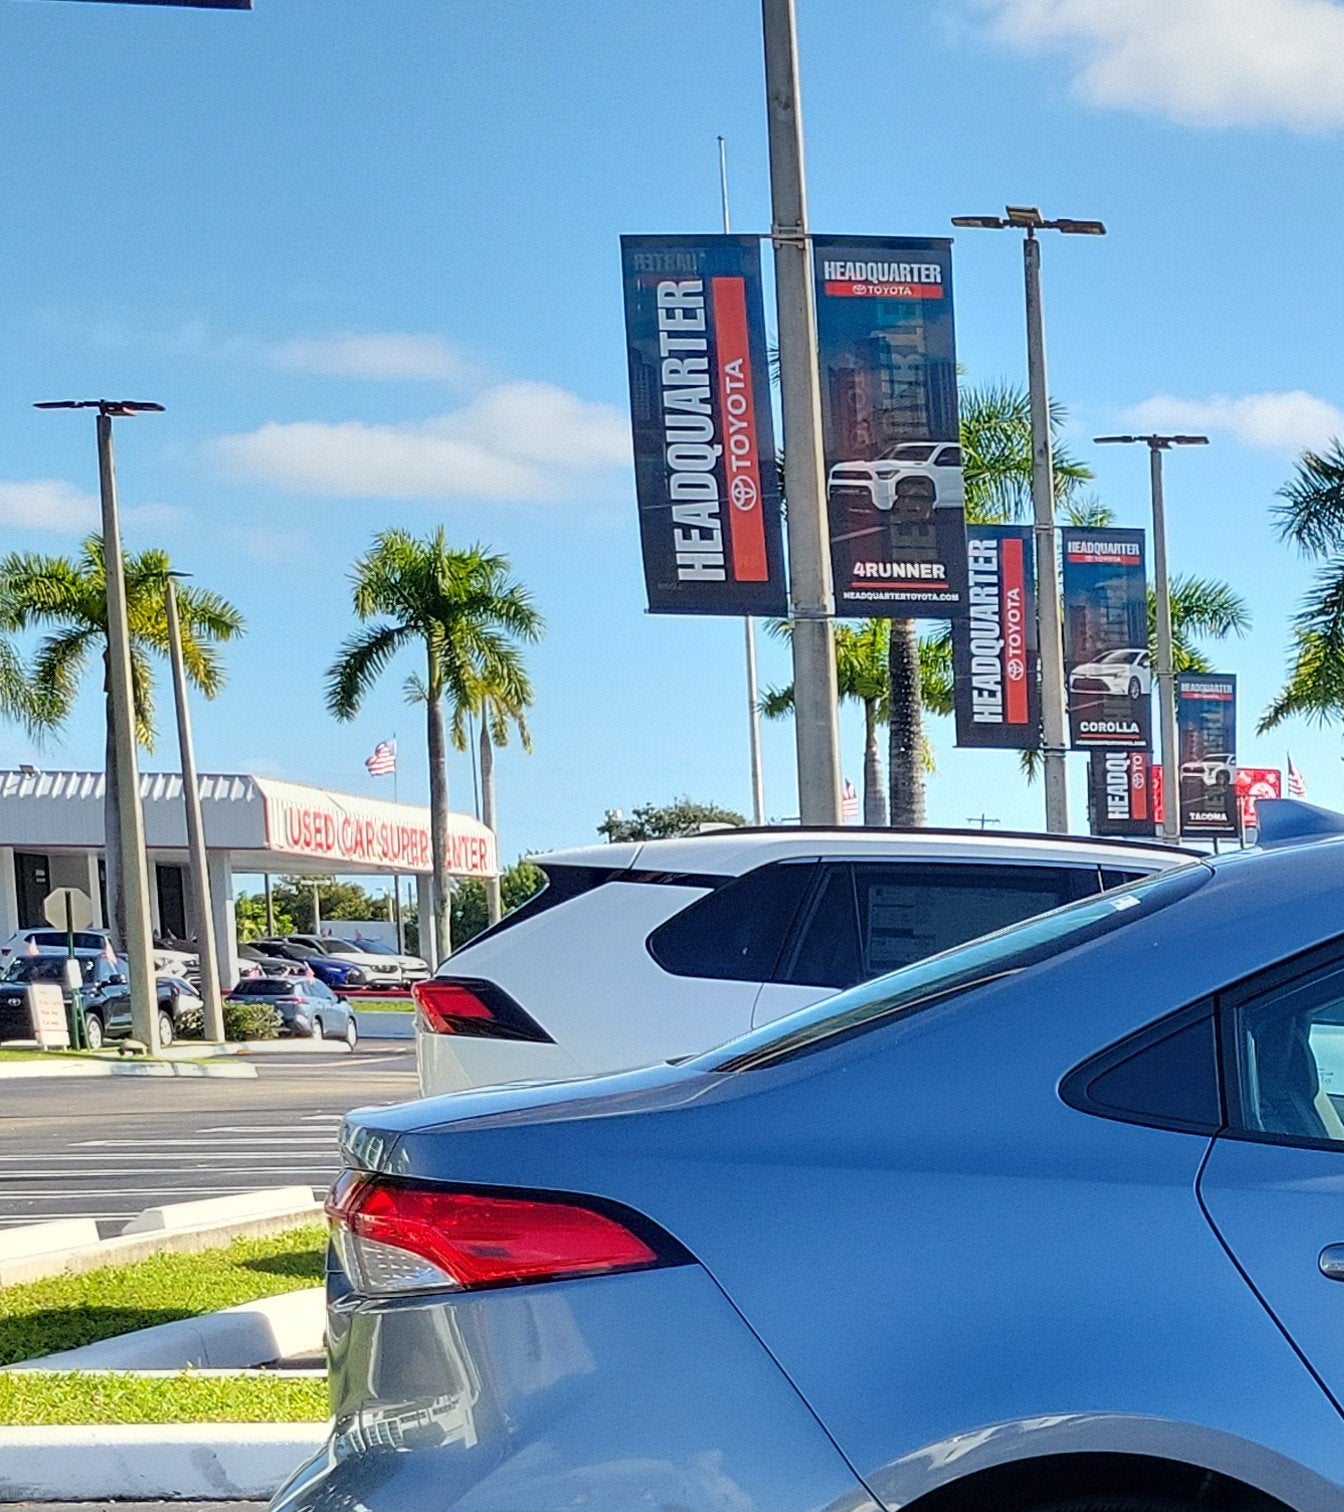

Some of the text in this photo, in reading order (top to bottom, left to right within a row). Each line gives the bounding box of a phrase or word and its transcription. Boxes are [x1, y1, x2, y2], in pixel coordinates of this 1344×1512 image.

[824, 261, 942, 283] HEADQUARTER
[868, 285, 912, 296] TOYOTA
[723, 358, 752, 472] TOYOTA
[657, 280, 726, 581] HEADQUARTER
[1067, 541, 1140, 556] HEADQUARTER
[853, 561, 946, 579] 4RUNNER
[968, 539, 1003, 724] HEADQUARTER
[1007, 588, 1025, 657] TOYOTA
[1080, 721, 1139, 733] COROLLA
[1189, 812, 1228, 822] TACOMA
[289, 807, 488, 870] USED CAR SUPER ENTER
